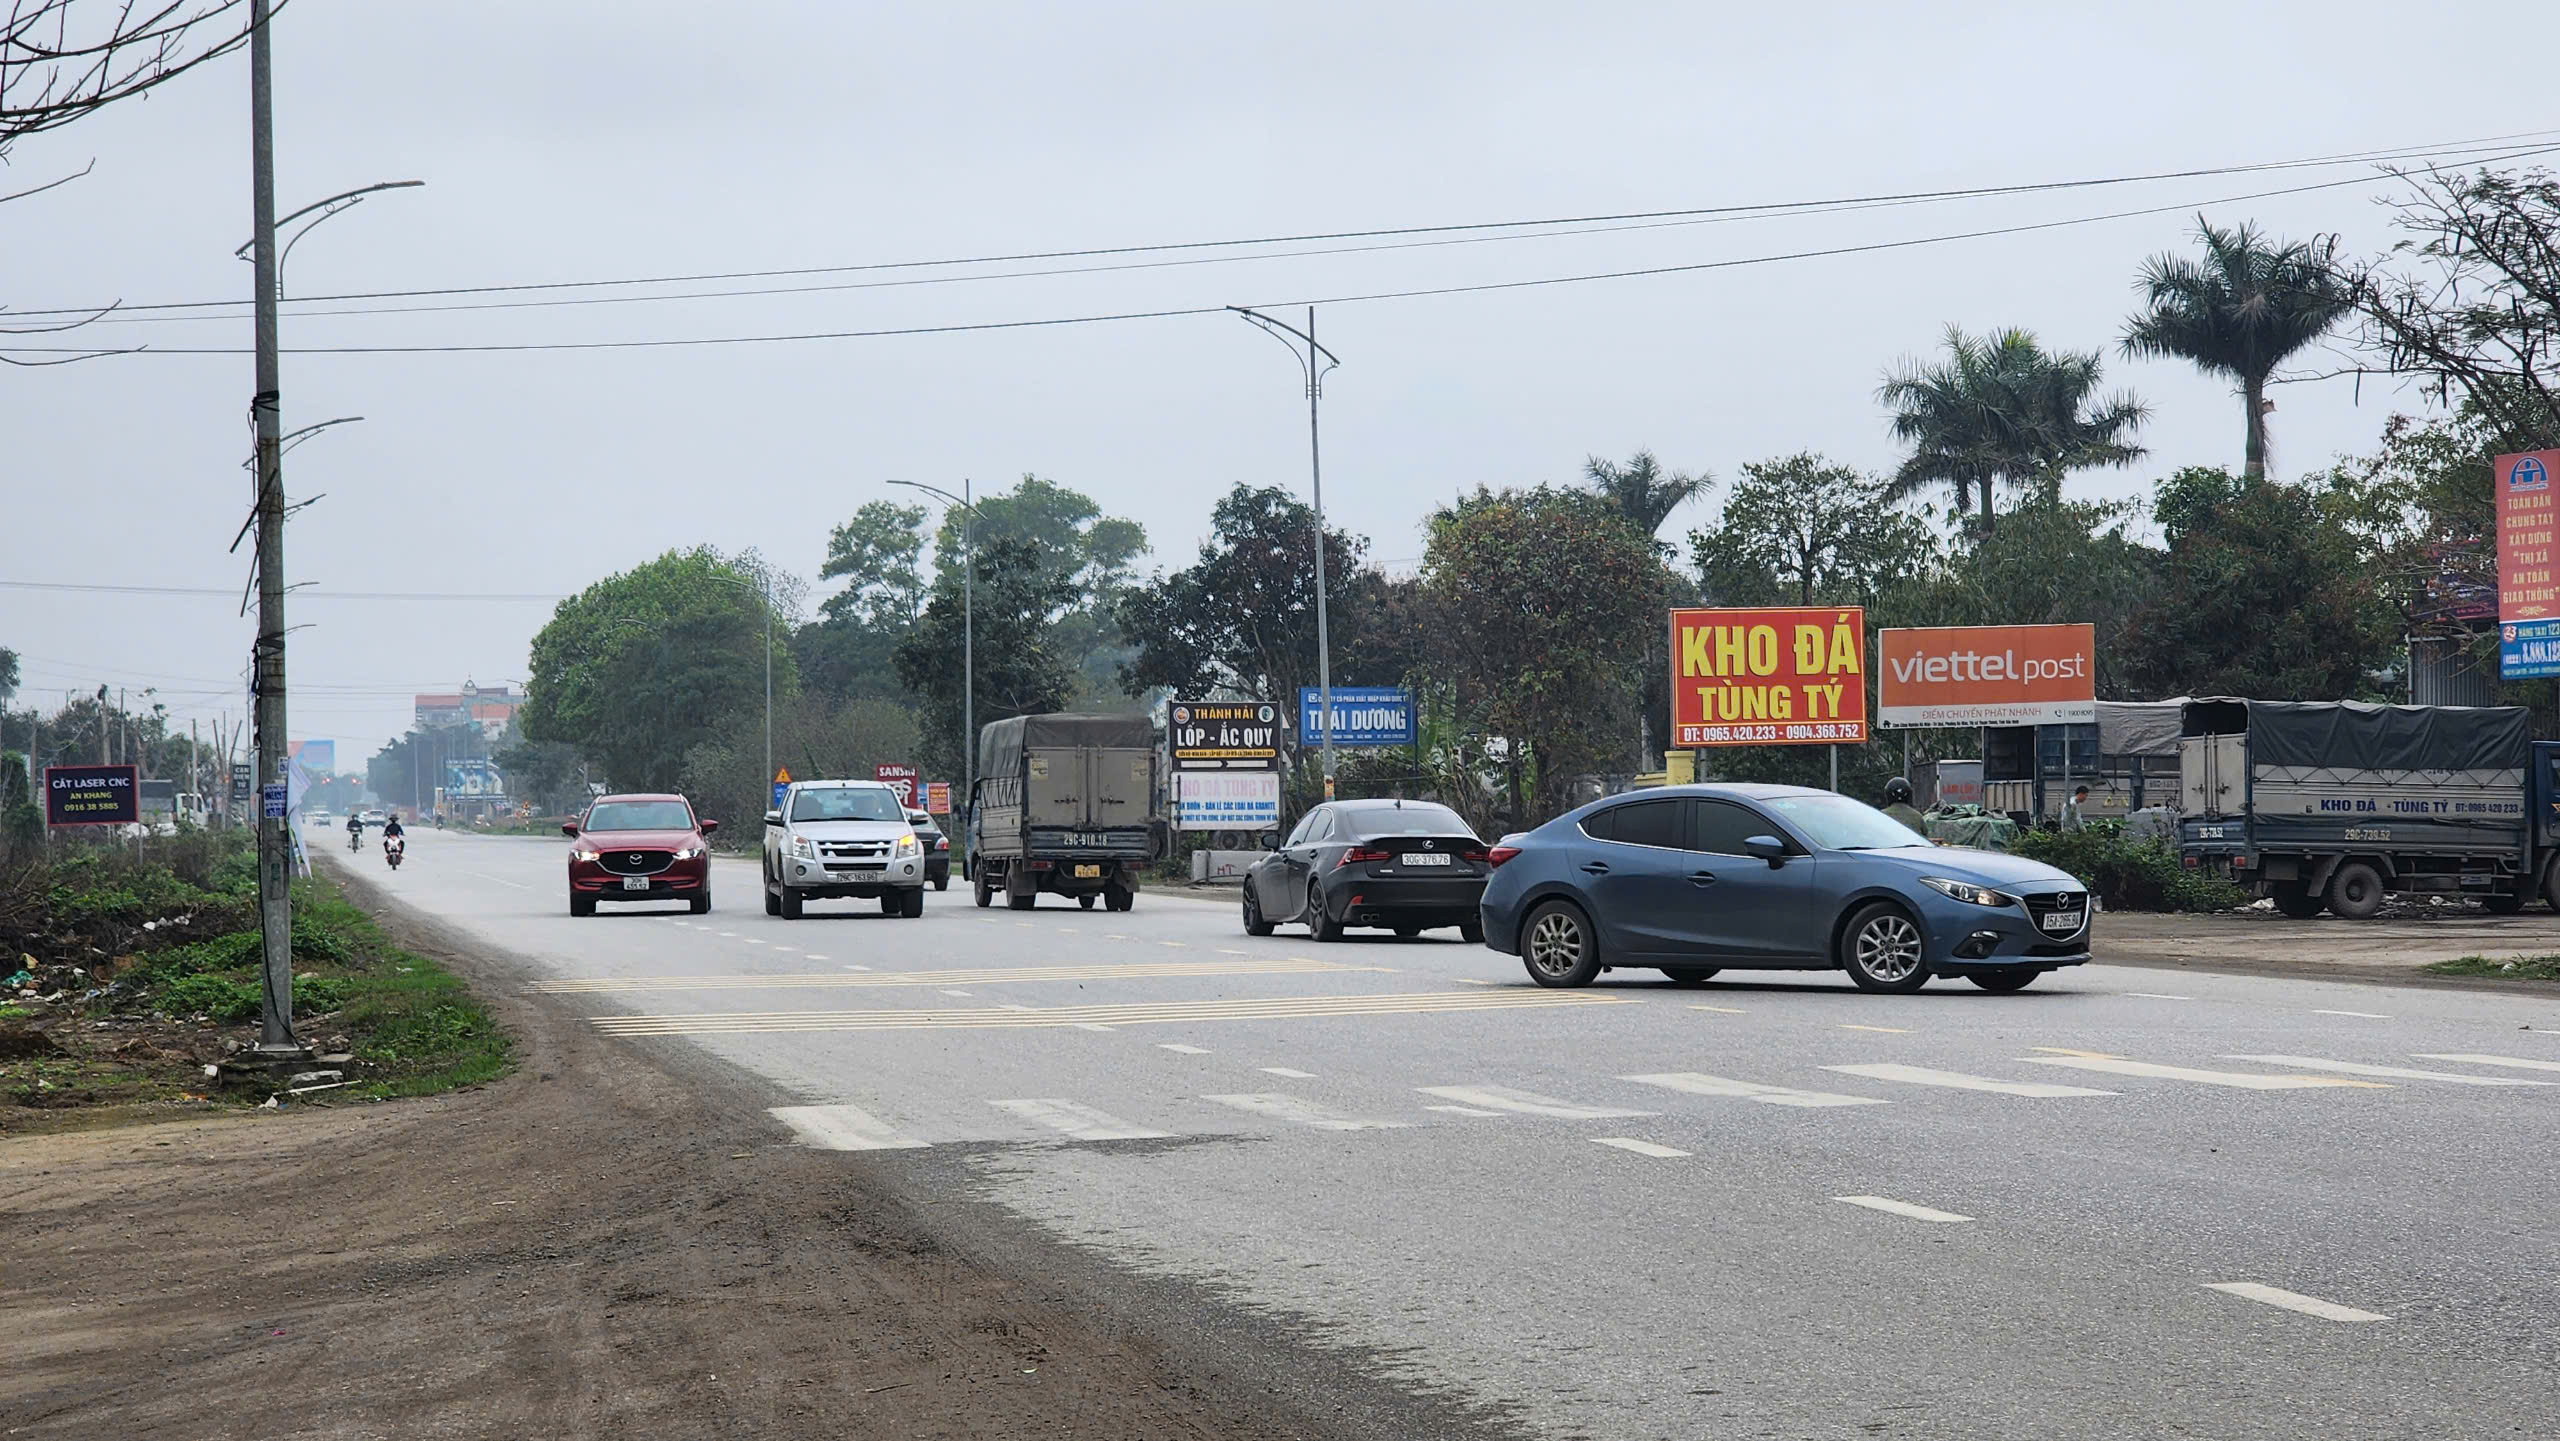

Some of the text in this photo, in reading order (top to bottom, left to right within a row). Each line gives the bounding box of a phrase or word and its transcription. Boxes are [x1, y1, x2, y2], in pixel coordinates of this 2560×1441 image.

[2506, 513, 2554, 528] CHUNG TAY
[2512, 572, 2525, 584] AN
[2503, 591, 2526, 603] GIAO
[1681, 613, 1861, 677] KHO ĐÁ
[1891, 649, 2085, 685] viettel post
[1696, 678, 1844, 721] TÙNG TÝ
[1194, 705, 1254, 719] THÀNH HẢI
[1351, 707, 1407, 731] DƯƠNG
[1177, 721, 1206, 747] LỐP
[1219, 721, 1239, 746] ẮC
[1243, 728, 1273, 748] QUY
[1684, 726, 1700, 741] ĐT:
[1703, 725, 1776, 741] 0965.420.233
[1786, 724, 1859, 739] 0904.368.752
[74, 779, 106, 788] LASER
[108, 778, 129, 787] CNC
[70, 791, 112, 800] AN KHANG
[64, 803, 85, 811] 0916
[2320, 799, 2352, 812] KHO
[2356, 798, 2377, 811] ĐÁ
[2488, 803, 2502, 813] 420
[2503, 803, 2518, 813] 233
